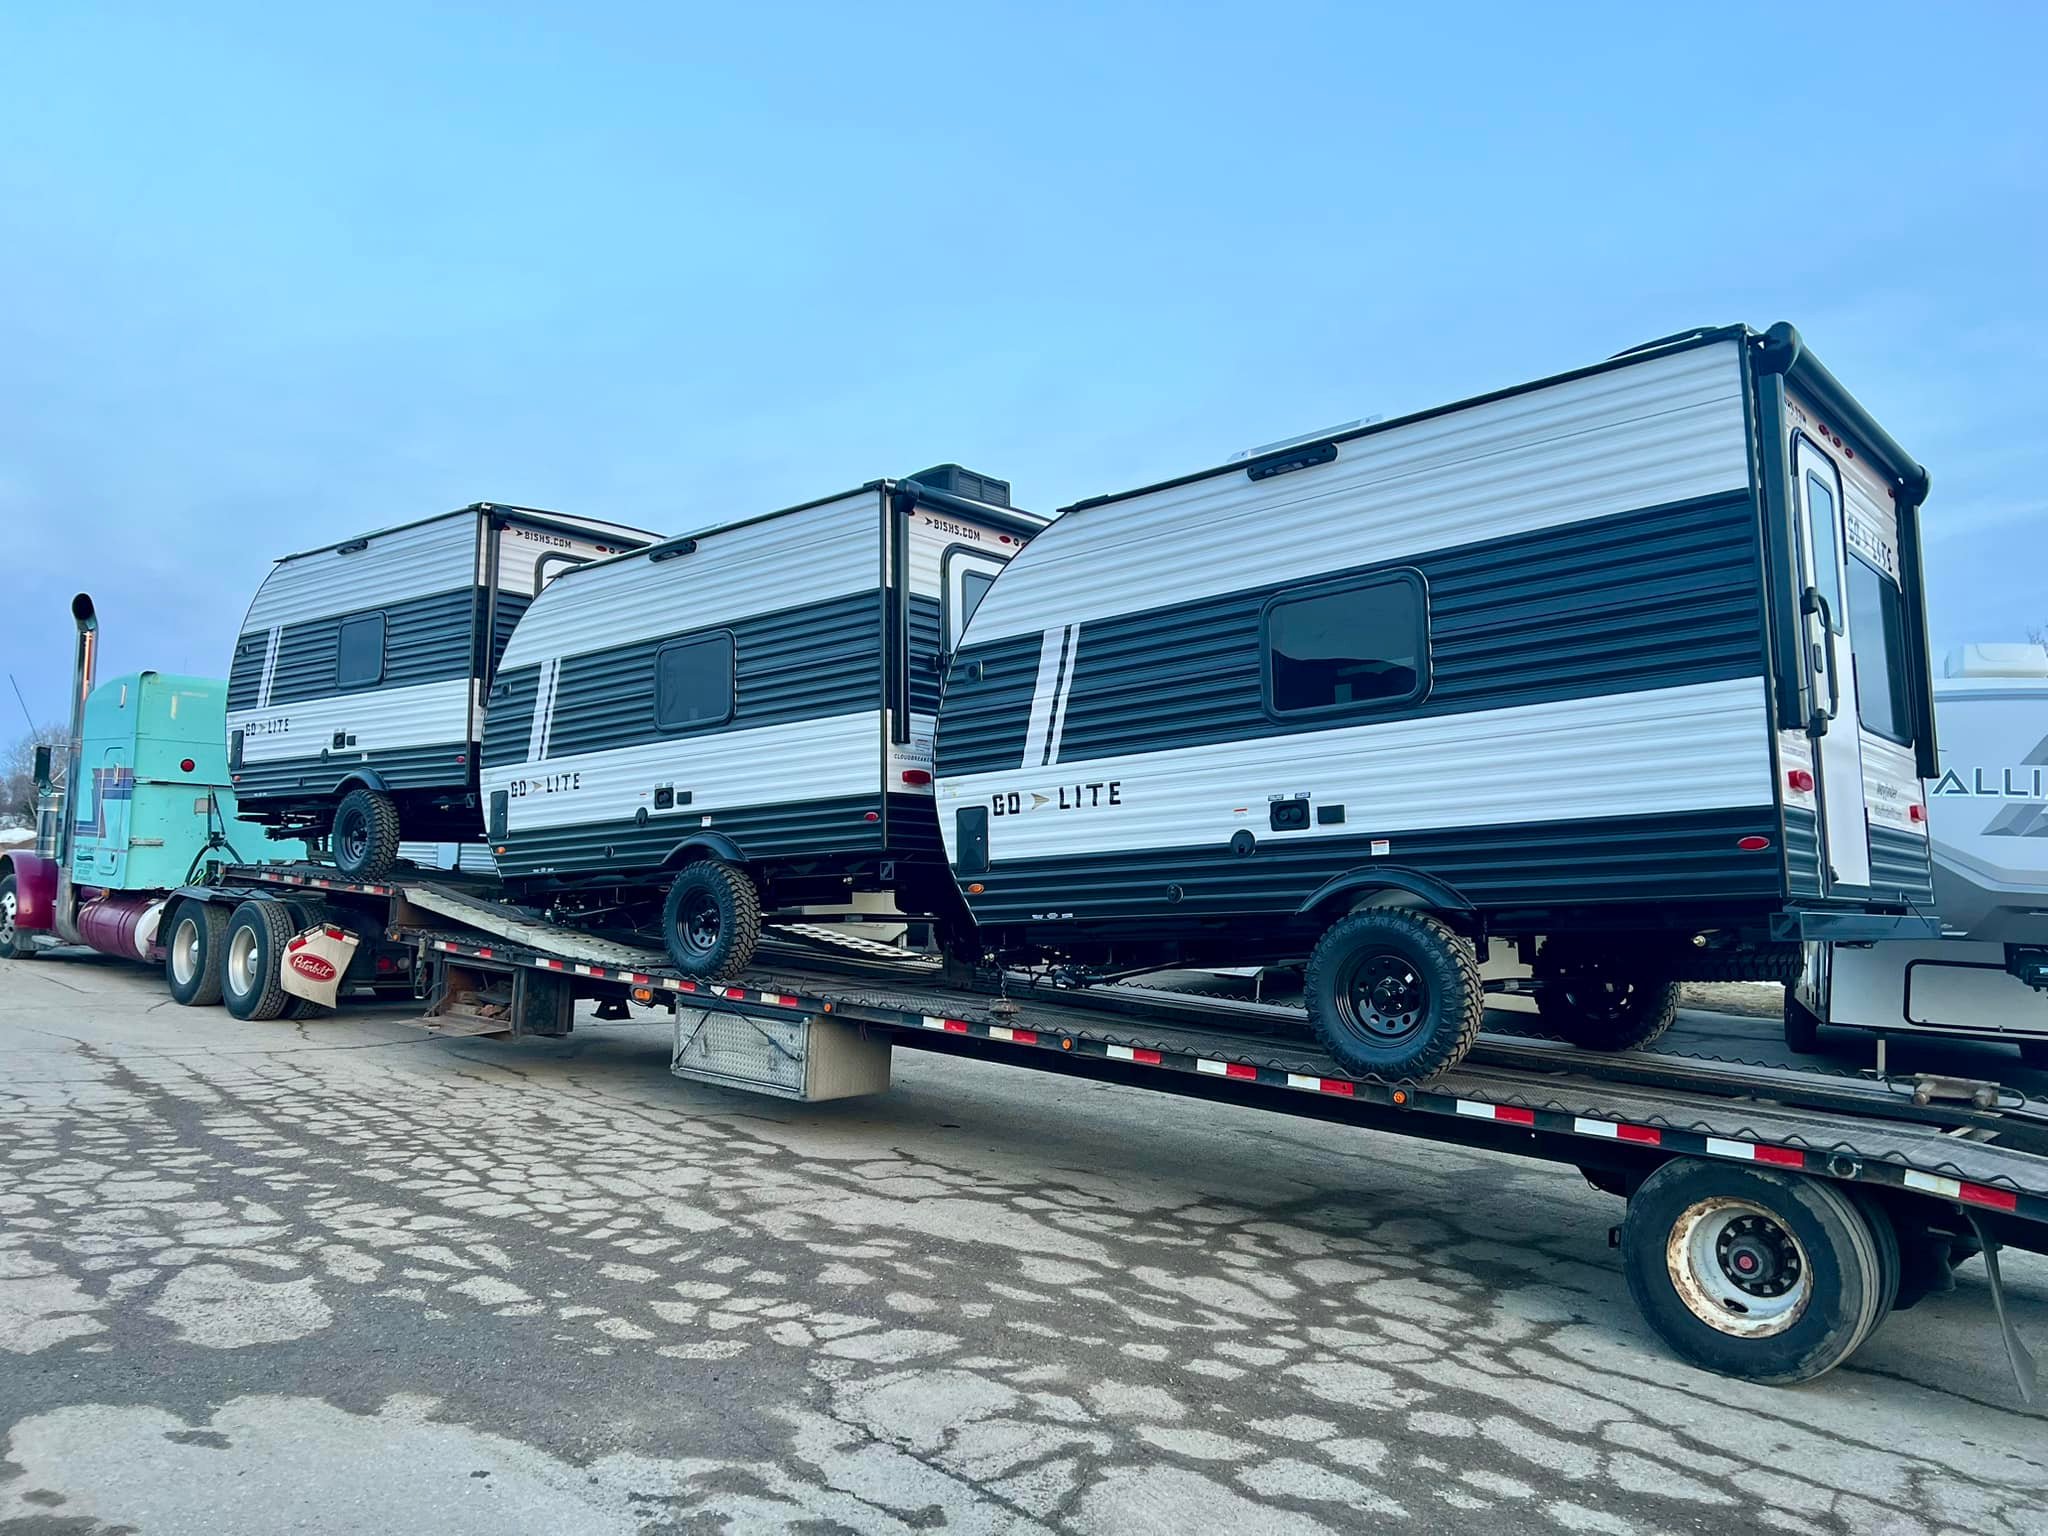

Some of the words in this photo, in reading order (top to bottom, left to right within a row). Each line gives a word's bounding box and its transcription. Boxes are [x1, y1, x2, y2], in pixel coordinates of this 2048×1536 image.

[524, 531, 572, 549] BISHS.COM
[934, 519, 981, 541] BISHS.COM
[246, 722, 256, 736] GO
[268, 718, 289, 733] LITE
[511, 780, 527, 798] GO
[546, 773, 580, 793] LITE
[1931, 767, 2048, 798] ALLI
[992, 792, 1021, 817] GO
[1058, 781, 1122, 810] LITE
[293, 955, 334, 977] Peterbilt
